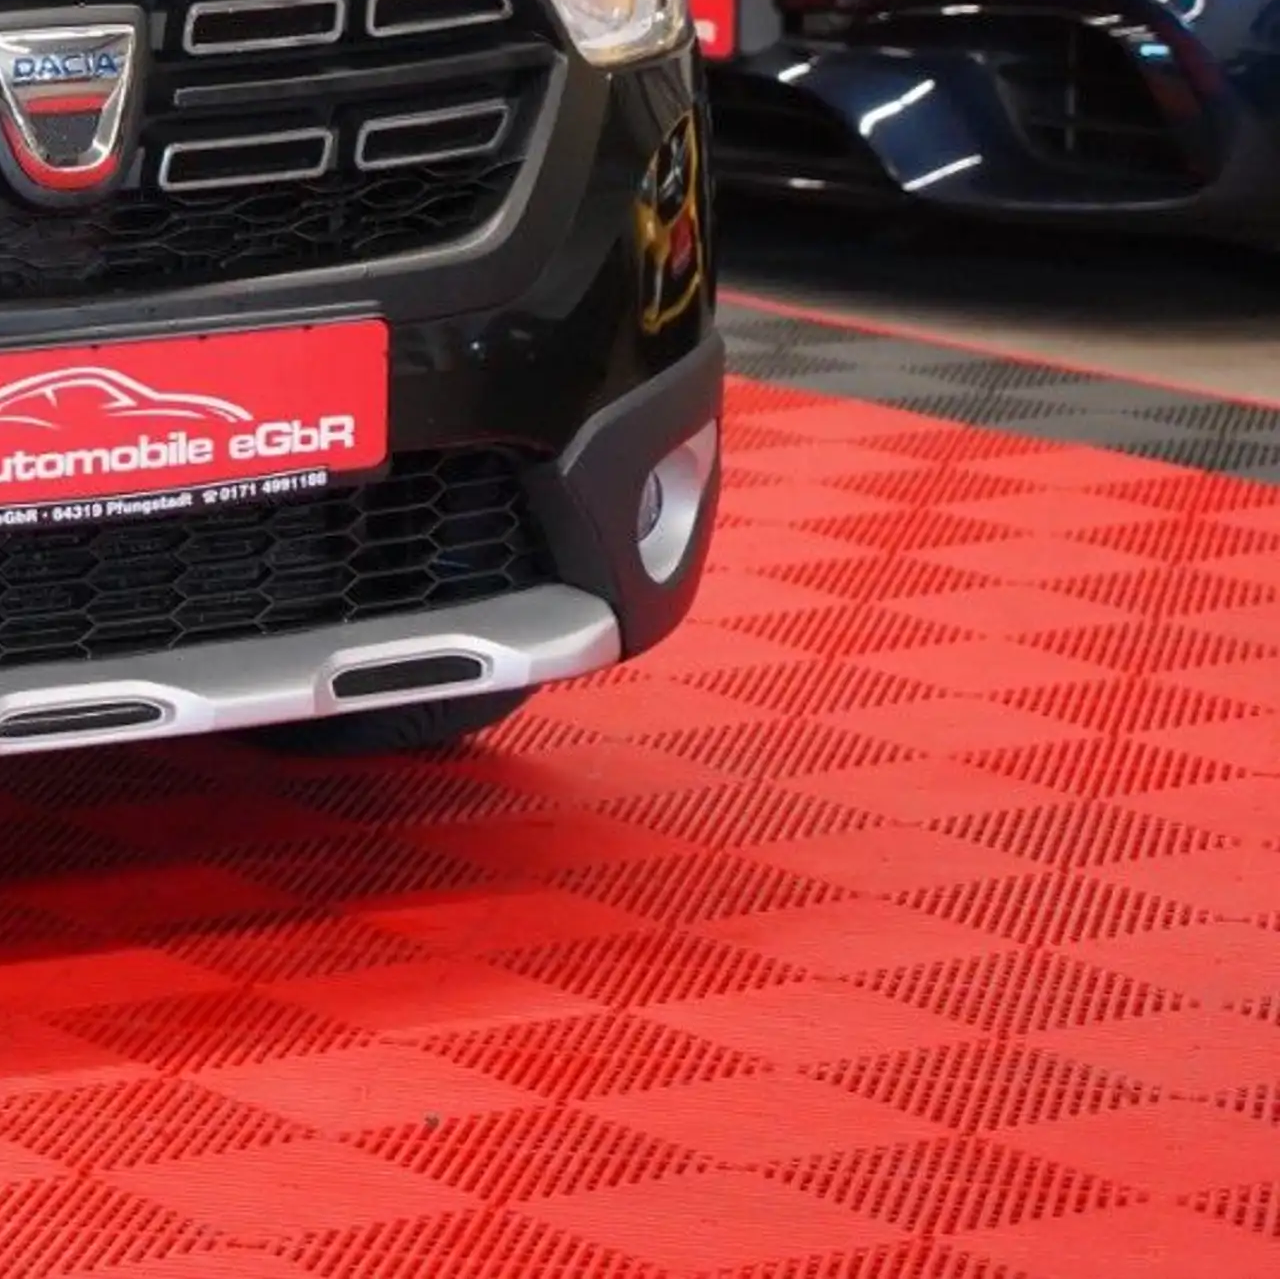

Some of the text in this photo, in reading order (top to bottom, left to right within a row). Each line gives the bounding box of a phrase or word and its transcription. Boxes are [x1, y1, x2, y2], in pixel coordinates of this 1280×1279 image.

[13, 53, 118, 78] DACIA
[228, 415, 355, 460] eGbR
[51, 503, 103, 522] 64319
[219, 482, 257, 501] 0171
